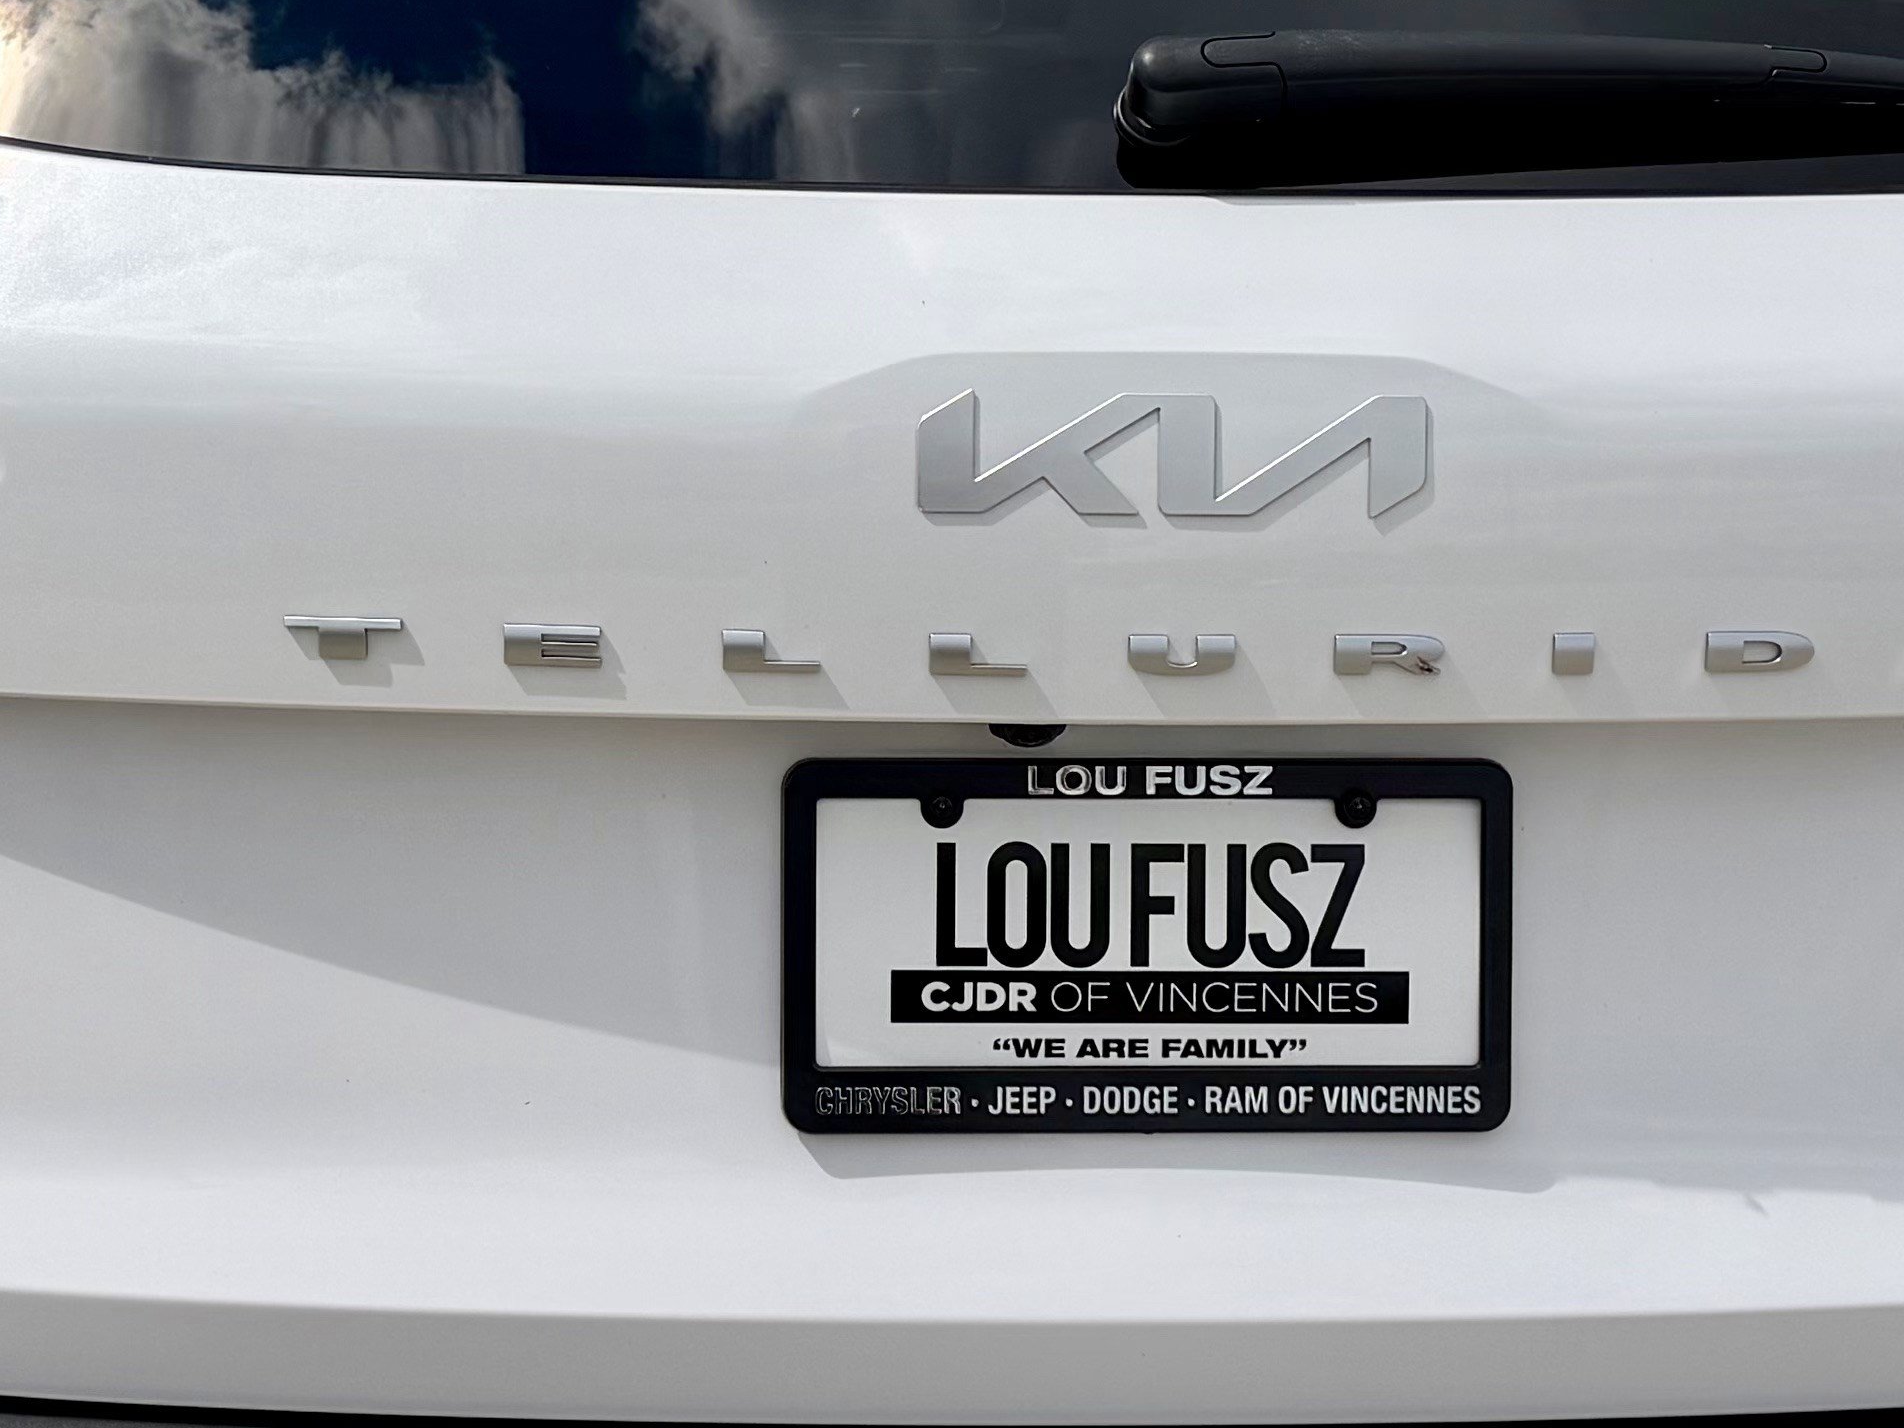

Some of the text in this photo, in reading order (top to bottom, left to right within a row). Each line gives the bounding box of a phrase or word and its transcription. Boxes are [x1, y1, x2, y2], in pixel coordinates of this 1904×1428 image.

[1026, 764, 1274, 796] LOU FUSZ
[935, 840, 1366, 969] LOU FUSZ
[920, 981, 1378, 1013] CJDR OF VINCENNES
[992, 1037, 1307, 1059] “WE ARE FAMILY”
[815, 1085, 1481, 1115] CHRYSLER JEEP DODGE RAM OF VINCENNES
